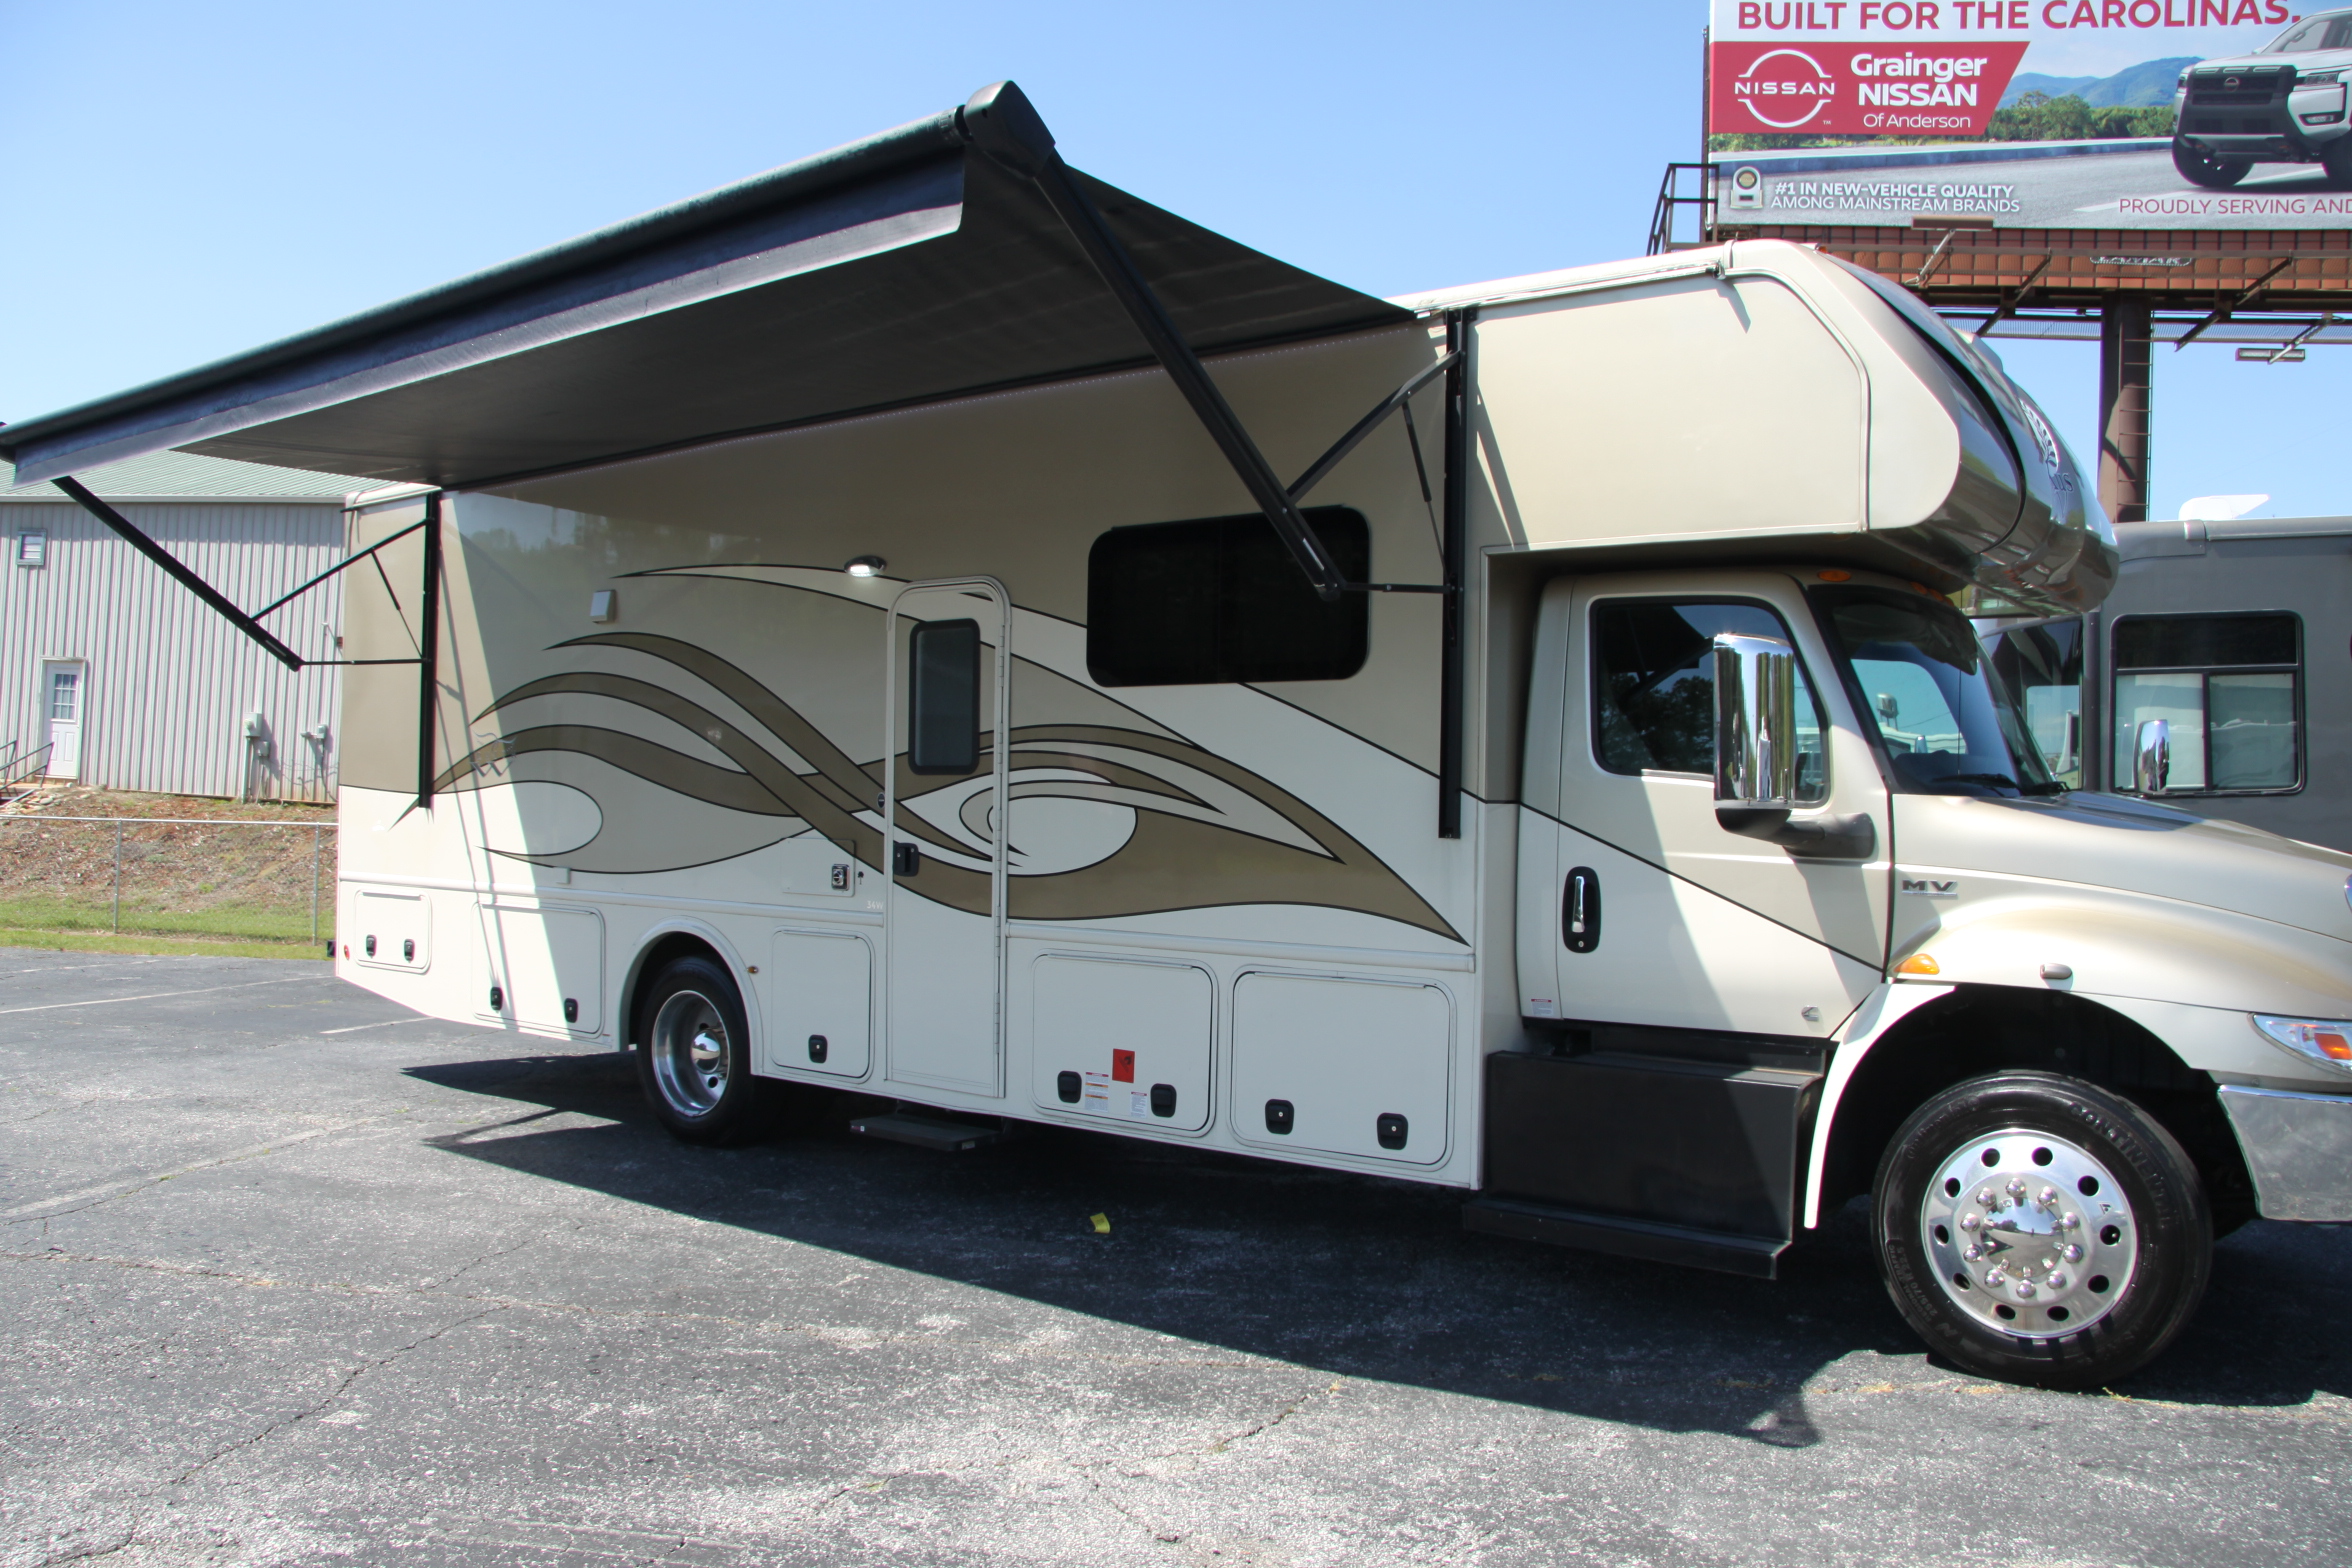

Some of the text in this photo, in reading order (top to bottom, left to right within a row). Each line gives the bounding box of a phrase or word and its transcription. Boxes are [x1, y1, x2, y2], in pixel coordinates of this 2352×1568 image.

[1738, 0, 2302, 30] BUILT FOR THE CAROLINAS.
[1850, 52, 1988, 82] Grainger
[1734, 81, 1835, 95] NISSAN
[1858, 83, 1977, 106] NISSAN
[1863, 112, 1971, 128] Of Anderson
[1775, 182, 2015, 199] #1 IN NEW-VEHICLE QUALITY
[1771, 196, 2020, 212] AMONG MAINSTREAM BRANDS
[2119, 199, 2211, 214] PROUDLY
[2217, 199, 2306, 214] SERVING
[1902, 879, 1957, 892] MV
